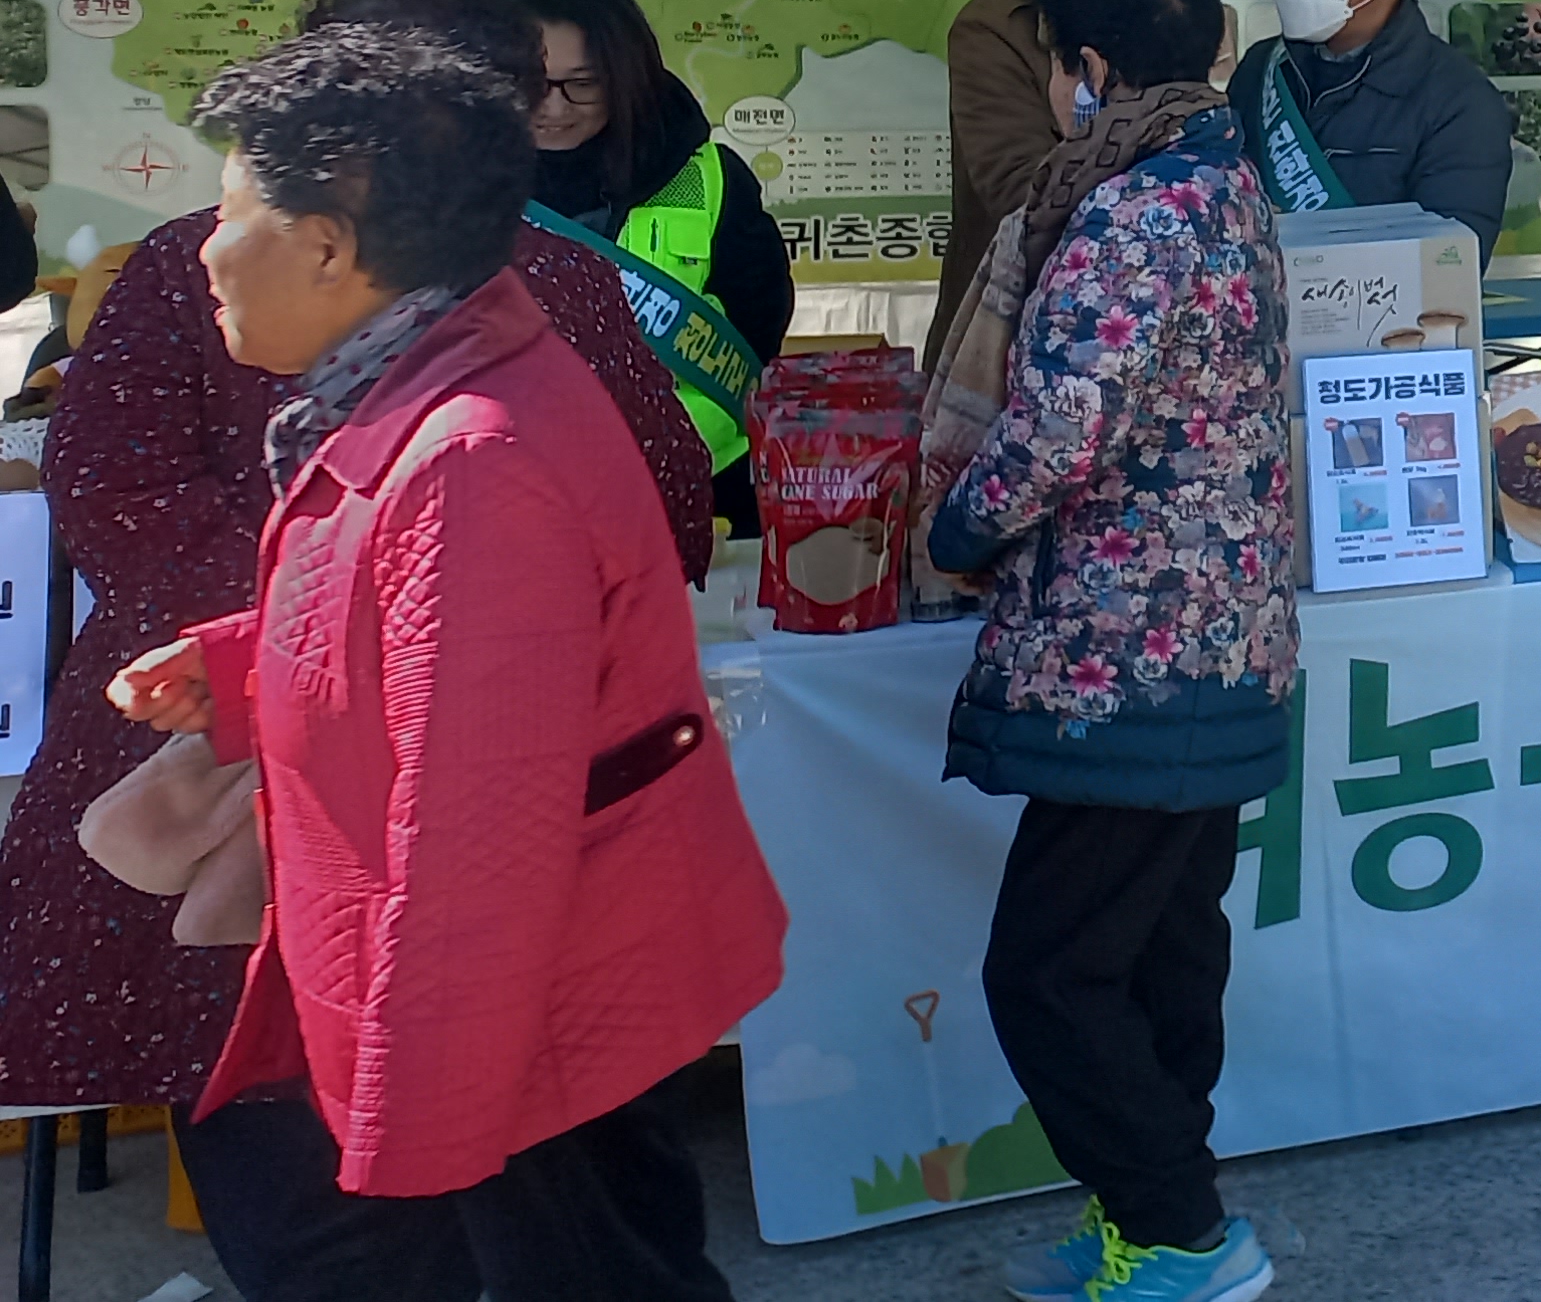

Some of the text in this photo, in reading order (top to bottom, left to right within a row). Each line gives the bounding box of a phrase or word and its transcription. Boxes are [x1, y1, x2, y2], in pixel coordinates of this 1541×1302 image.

[1267, 120, 1330, 213] 친환경
[1317, 371, 1466, 405] 청도가공식품
[820, 482, 880, 501] SUGAR
